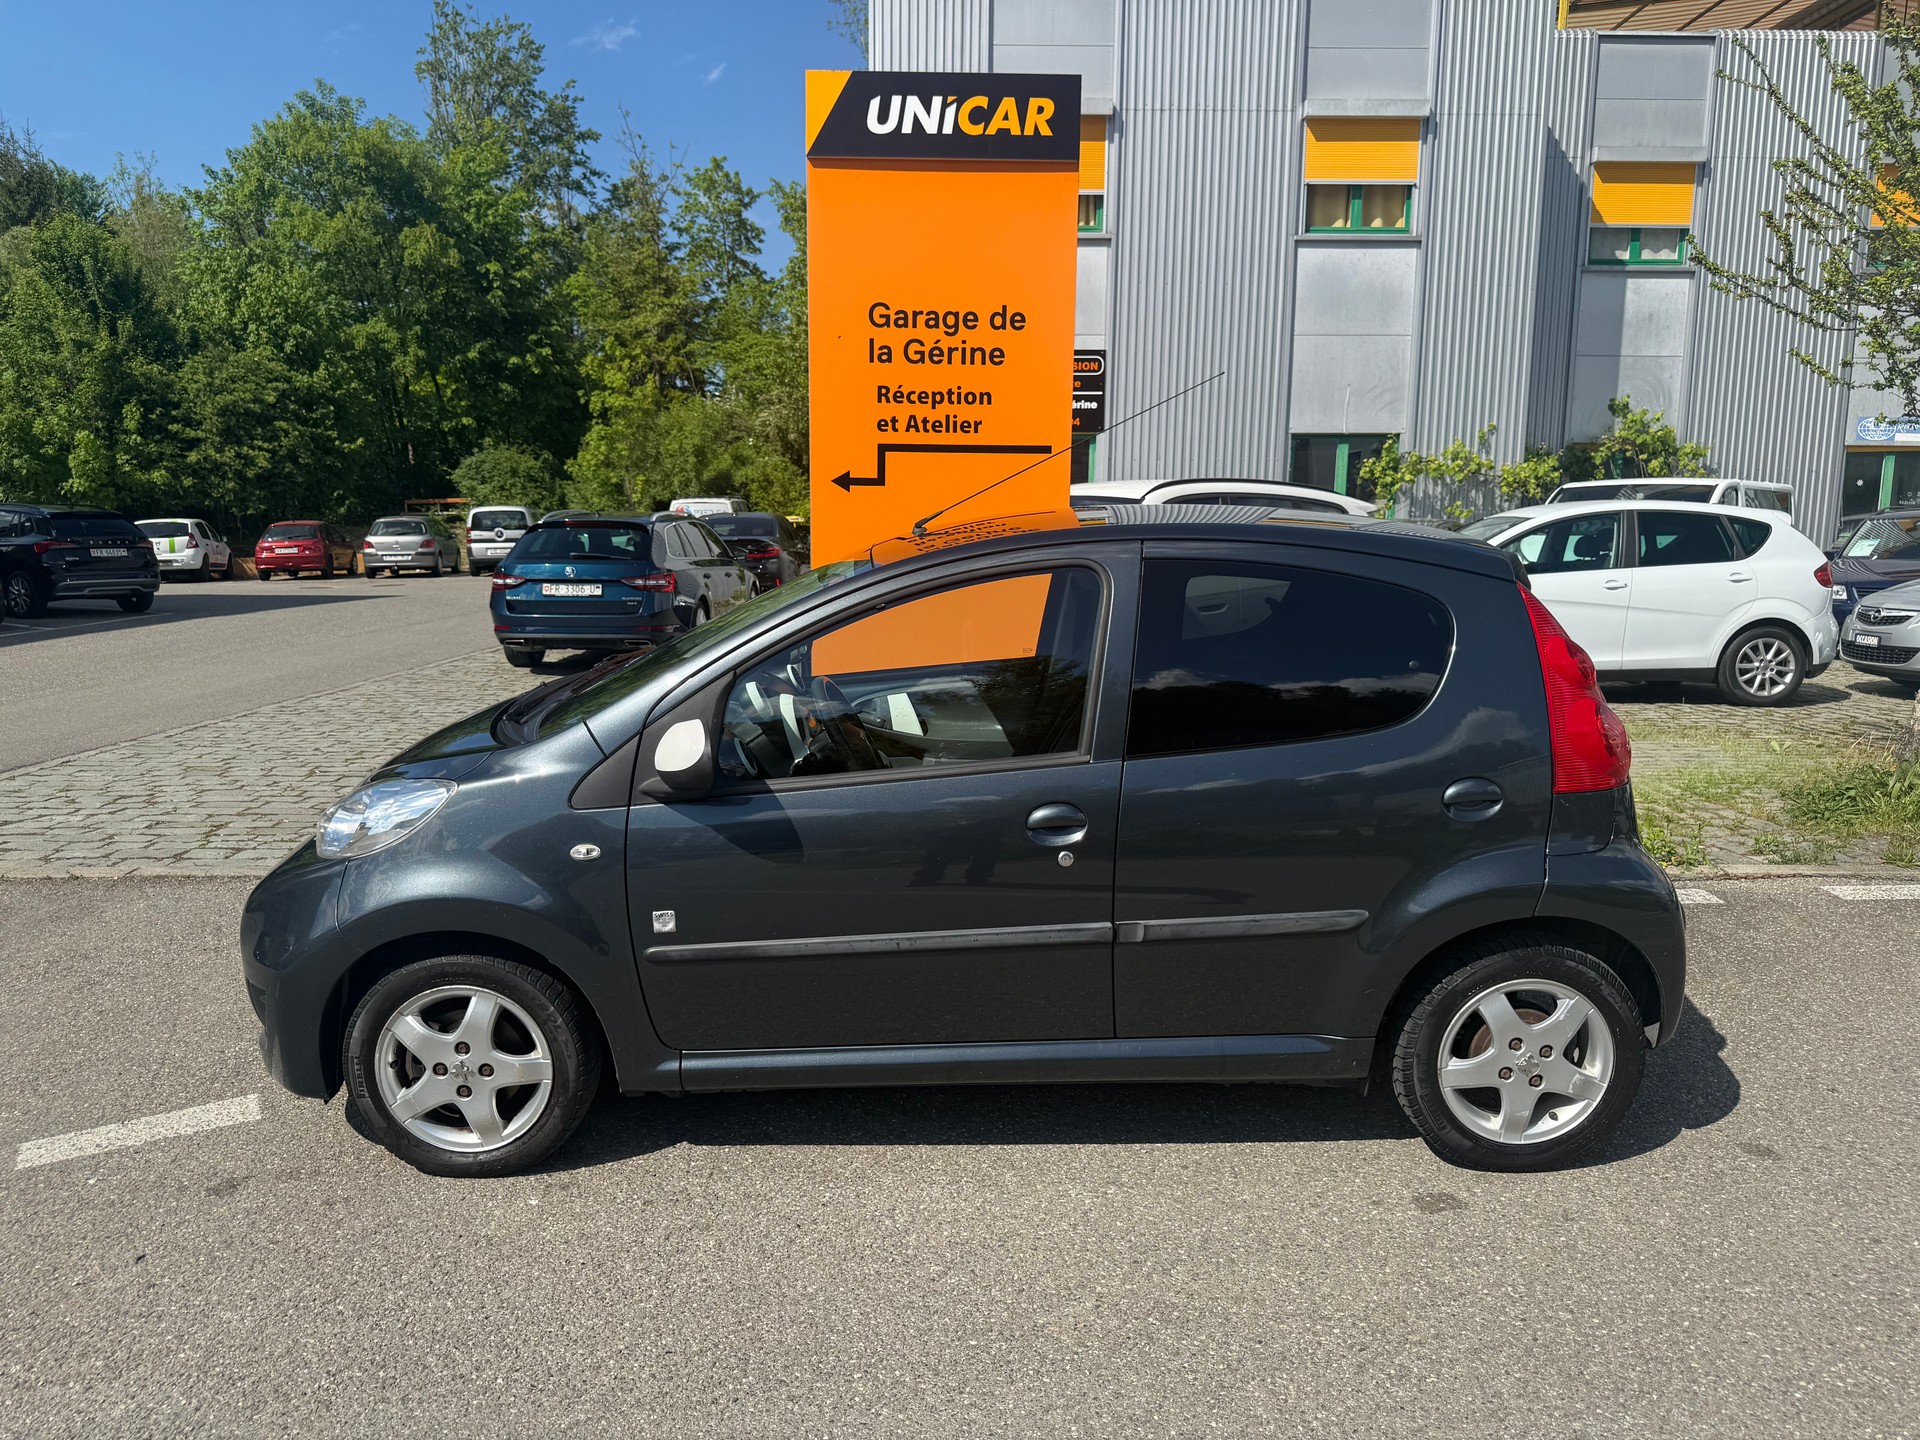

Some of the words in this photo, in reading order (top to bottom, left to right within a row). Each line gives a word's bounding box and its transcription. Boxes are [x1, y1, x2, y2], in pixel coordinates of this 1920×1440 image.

[868, 302, 979, 337] Garage
[989, 304, 1027, 331] de
[868, 338, 893, 364] la
[903, 338, 1006, 366] Gérine
[877, 384, 993, 410] Réception
[876, 416, 899, 433] et
[905, 414, 983, 434] Atelier
